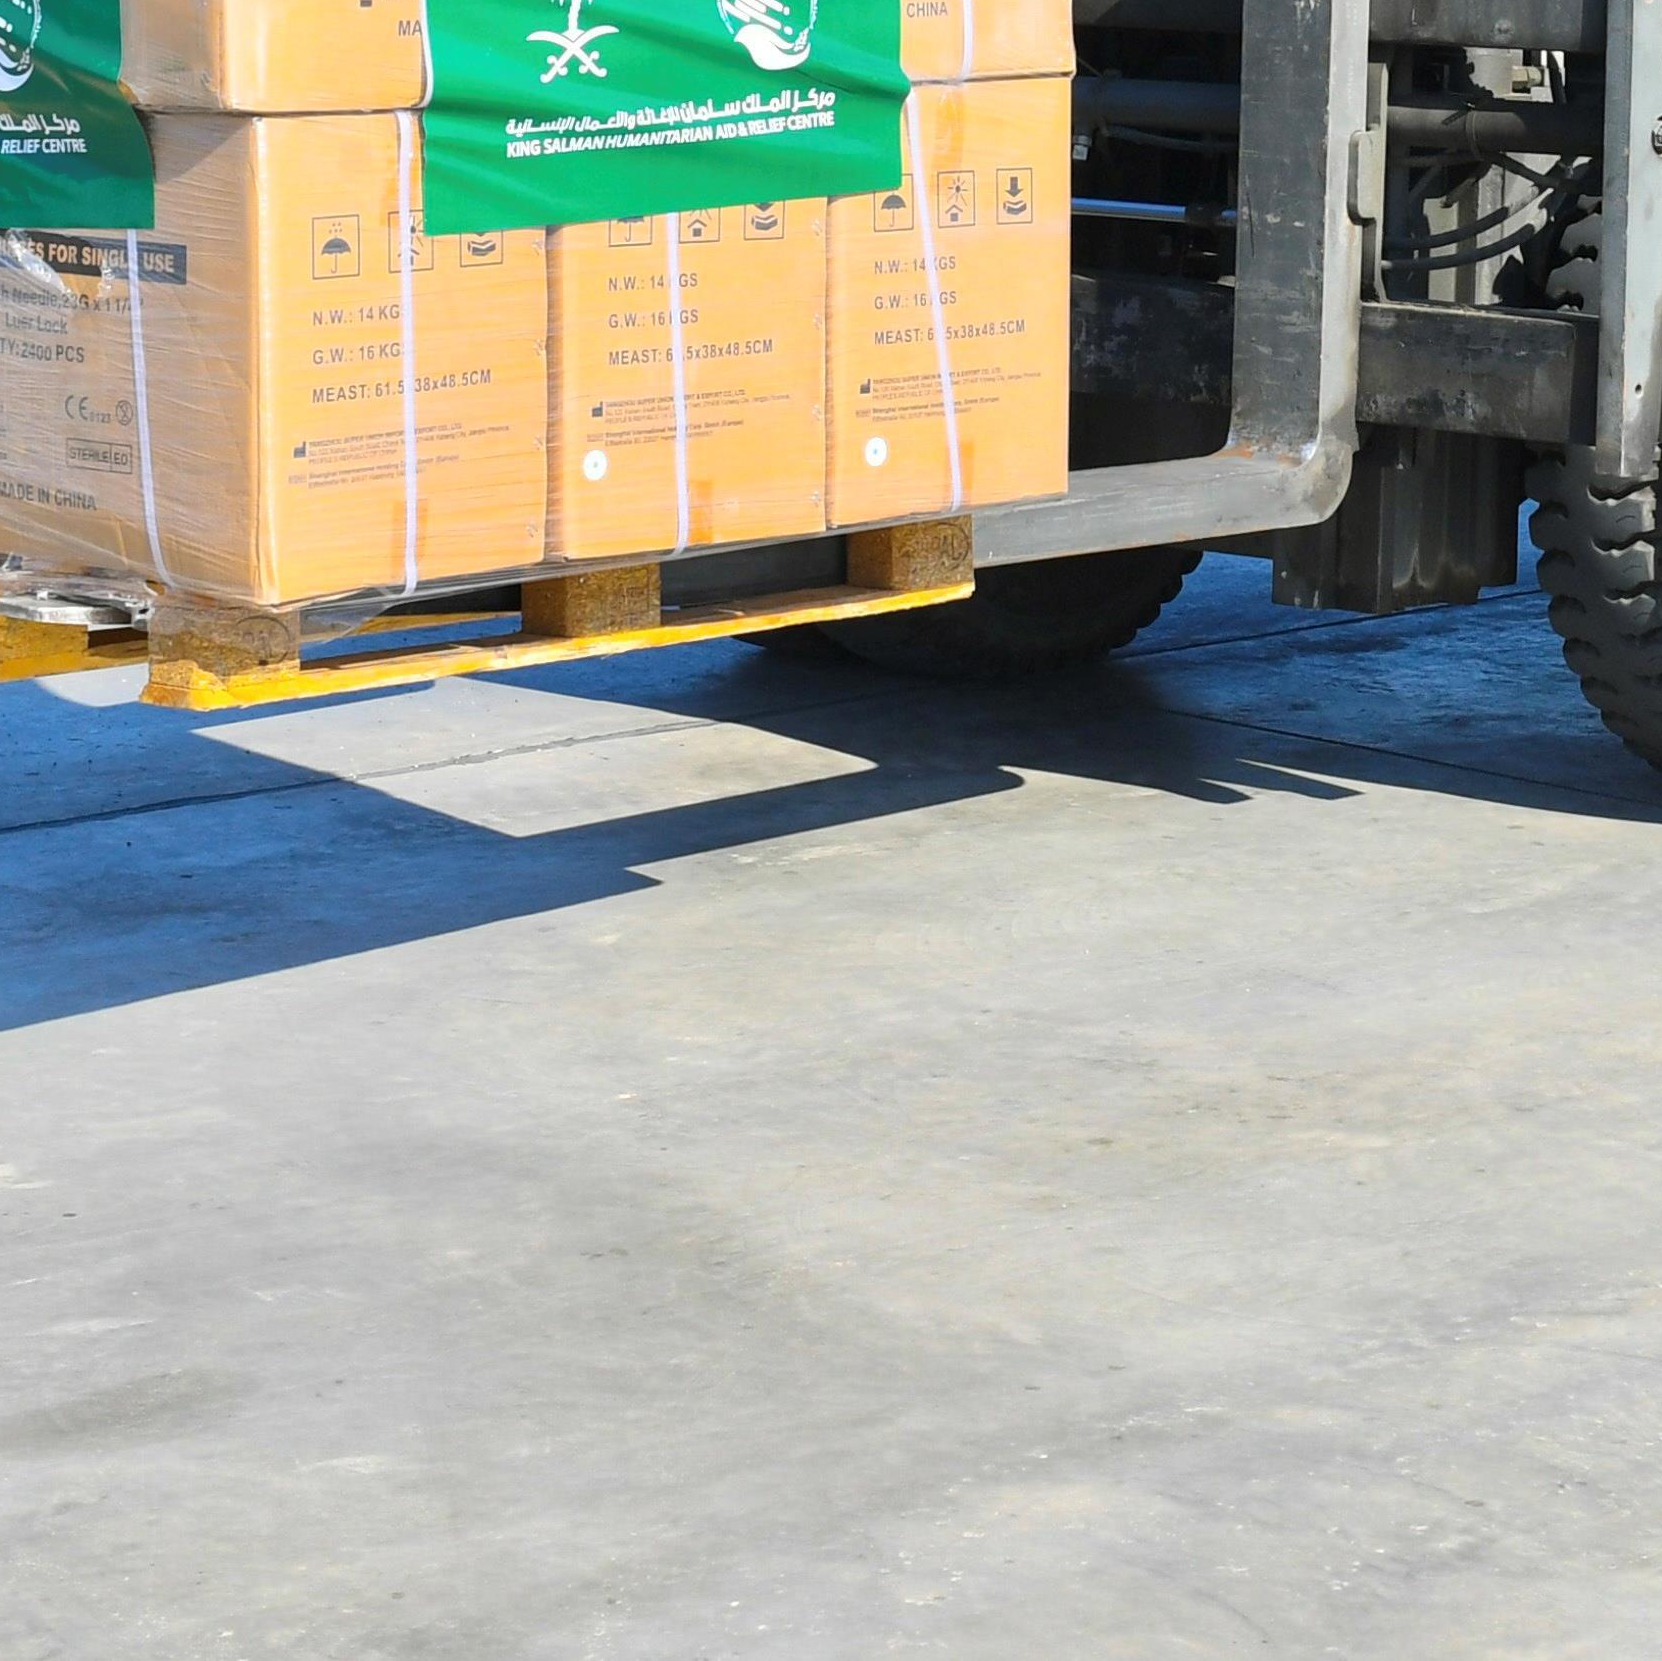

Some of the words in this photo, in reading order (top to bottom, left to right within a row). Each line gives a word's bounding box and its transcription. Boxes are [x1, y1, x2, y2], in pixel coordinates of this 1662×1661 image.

[907, 1, 948, 18] CHINA
[680, 99, 740, 123] سلمان
[741, 90, 790, 115] الملك
[791, 88, 835, 112] مركز
[44, 113, 81, 136] مركز
[506, 139, 542, 158] KING
[543, 134, 605, 155] SALMAN
[605, 125, 714, 150] HUMANITARIAN
[715, 123, 737, 140] AID
[737, 122, 748, 137] &
[747, 119, 787, 137] RELIEF
[788, 111, 835, 132] CENTRE
[1, 138, 41, 153] RELIEF
[42, 138, 87, 153] CENTRE
[48, 244, 78, 262] FOR
[82, 248, 136, 269] SINGL
[142, 253, 175, 273] USE
[874, 260, 908, 274] N.W.:
[913, 258, 926, 271] 14
[609, 276, 645, 291] N.W.:
[650, 275, 664, 289] 14
[669, 273, 698, 288] GS
[874, 295, 908, 310] G.W.:
[914, 293, 927, 307] 16
[930, 291, 957, 305] GS
[313, 309, 353, 326] N.W.:
[359, 306, 374, 322] 14
[379, 304, 405, 320] KG
[609, 313, 645, 328] G.W.:
[651, 312, 665, 326] 16
[875, 328, 923, 345] MEAST:
[56, 344, 85, 364] PCS
[313, 348, 353, 365] G.W.:
[359, 345, 375, 361] 16
[379, 342, 405, 358] KG
[609, 348, 662, 366] MEAST:
[666, 339, 773, 362] 6.5x38x48.5CM
[313, 384, 371, 403] MEAST:
[375, 369, 492, 398] 61.538x48.5CM
[37, 486, 50, 504] IN
[54, 490, 97, 511] CHINA
